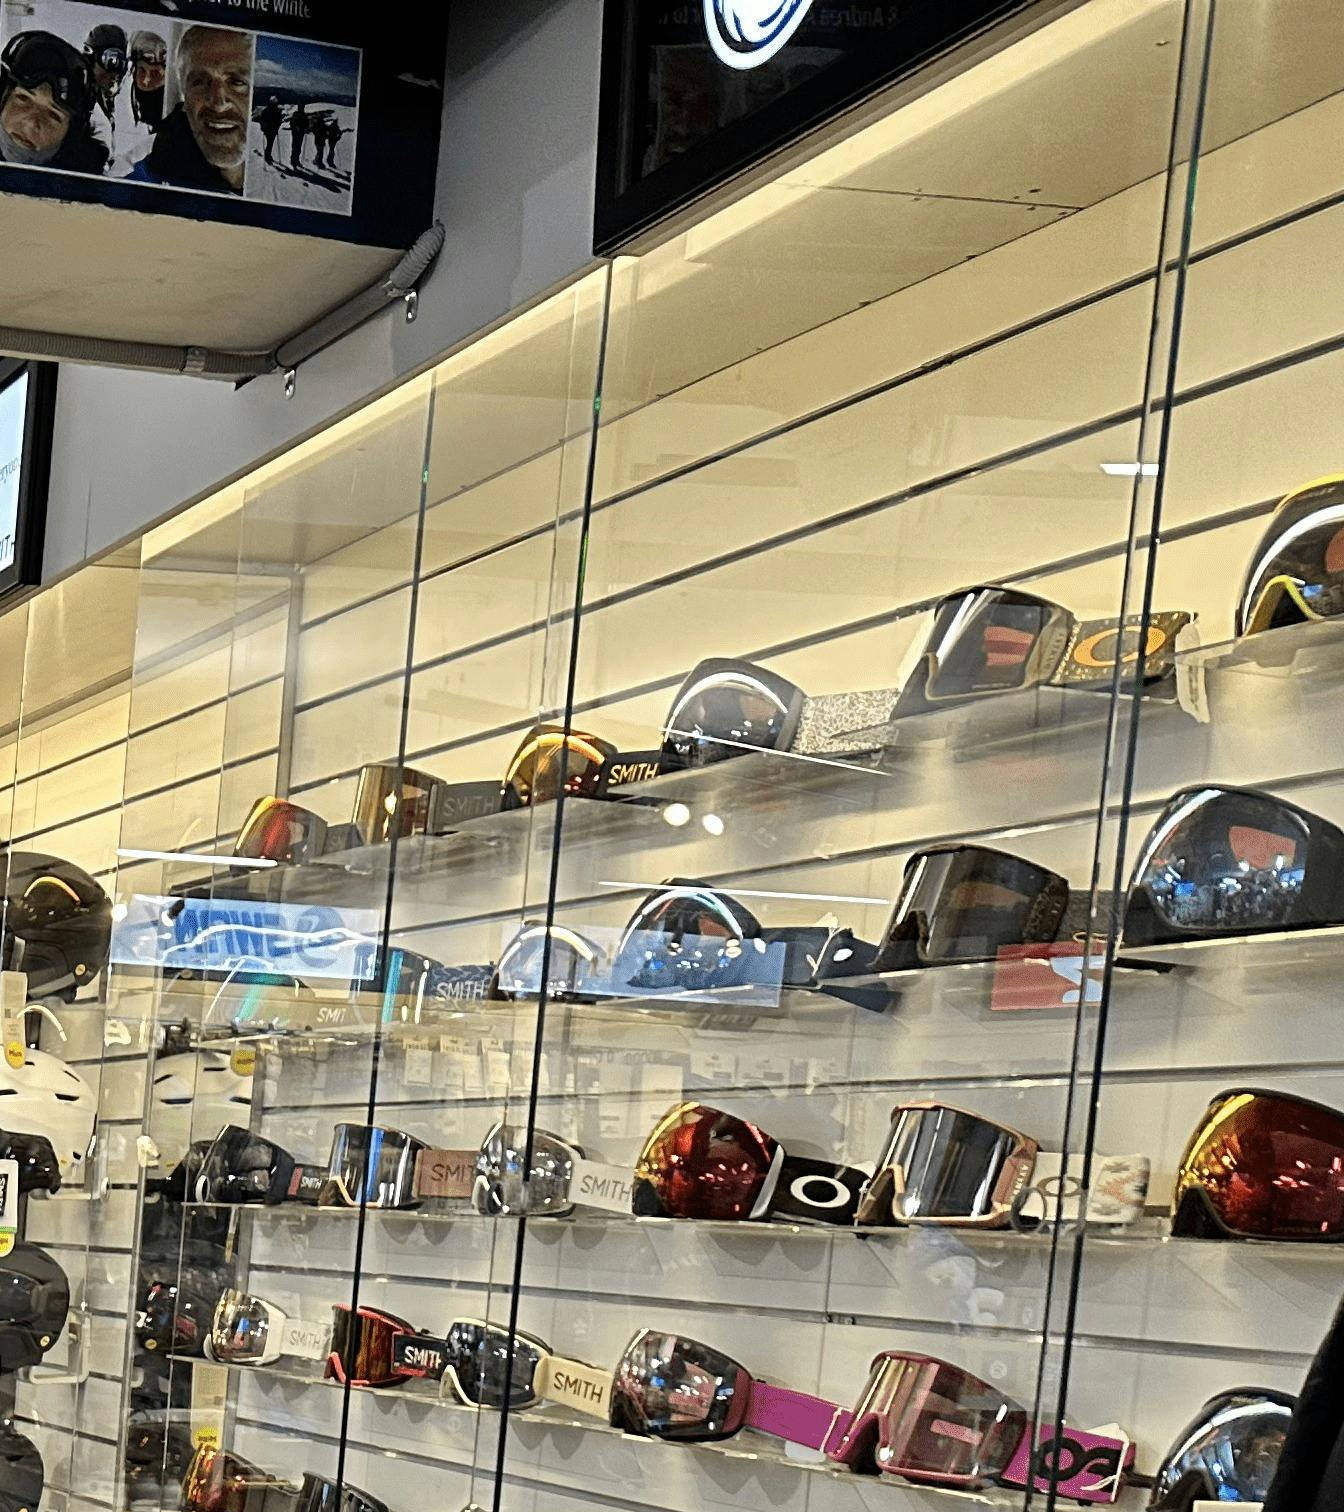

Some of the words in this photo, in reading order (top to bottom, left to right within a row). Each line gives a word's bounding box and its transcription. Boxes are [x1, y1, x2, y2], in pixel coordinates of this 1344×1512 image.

[273, 0, 312, 18] winte
[608, 762, 658, 784] SMITH
[443, 796, 495, 818] SMITH
[436, 980, 488, 1000] SMITH
[317, 1007, 347, 1024] SMIT
[431, 1164, 475, 1183] SMIT
[580, 1174, 632, 1201] SMITH
[553, 1371, 604, 1403] SMITH
